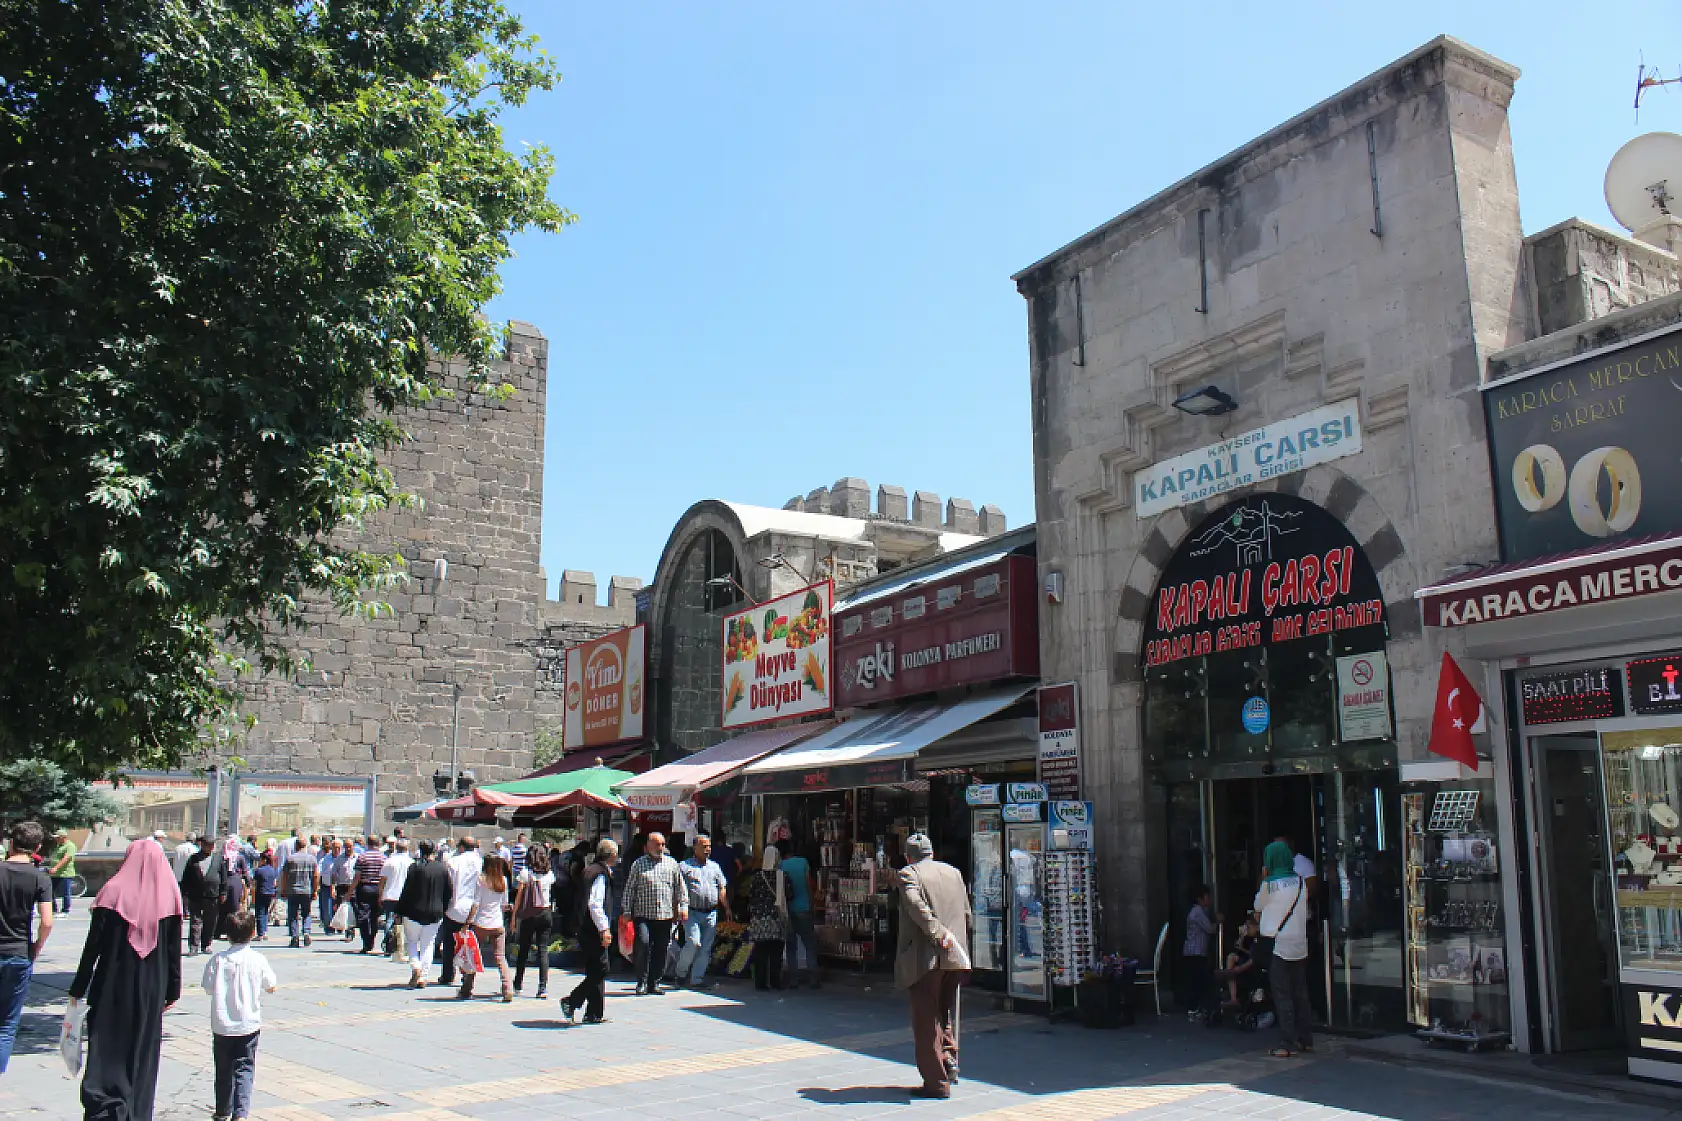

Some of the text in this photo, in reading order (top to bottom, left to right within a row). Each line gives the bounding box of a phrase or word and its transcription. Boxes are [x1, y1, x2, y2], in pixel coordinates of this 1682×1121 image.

[1498, 347, 1680, 418] KARACA MERCAN
[1551, 395, 1627, 432] SARRAF
[1140, 453, 1239, 503] KAPALI
[1157, 546, 1354, 632] KAPALI ÇARŞI
[1440, 559, 1682, 627] KARACA MERC
[754, 650, 797, 682] Meyve
[856, 642, 895, 689] zeki
[901, 646, 941, 671] KOLONYA
[750, 680, 802, 712] Dünyası
[1523, 679, 1568, 700] SAAT
[1638, 991, 1682, 1028] K
